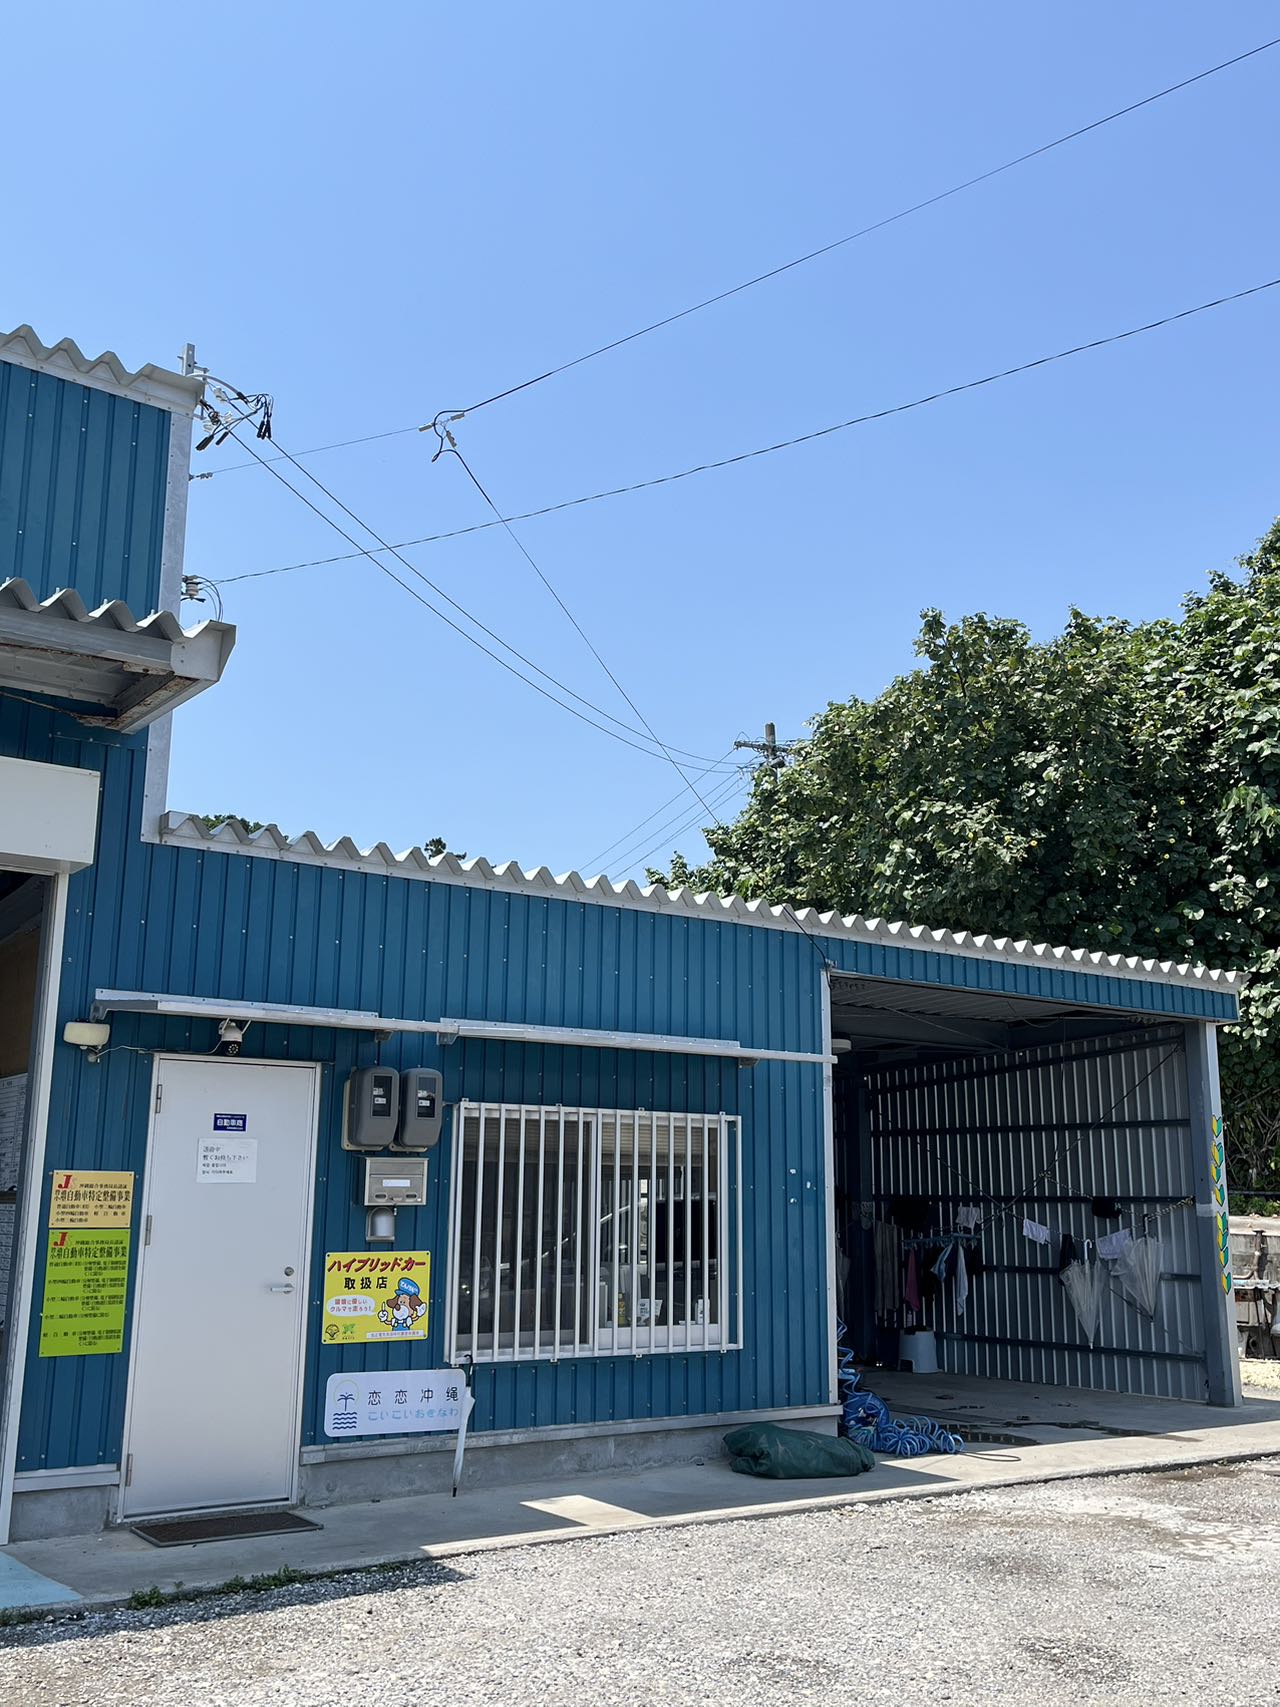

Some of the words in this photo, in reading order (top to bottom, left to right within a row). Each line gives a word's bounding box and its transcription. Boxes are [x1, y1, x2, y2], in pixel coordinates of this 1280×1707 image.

[327, 1256, 426, 1273] ハイブリッドカー
[344, 1276, 388, 1290] 取扱店
[368, 1387, 459, 1406] 恋恋冲绳
[368, 1408, 459, 1421] こいこいおきなわ
